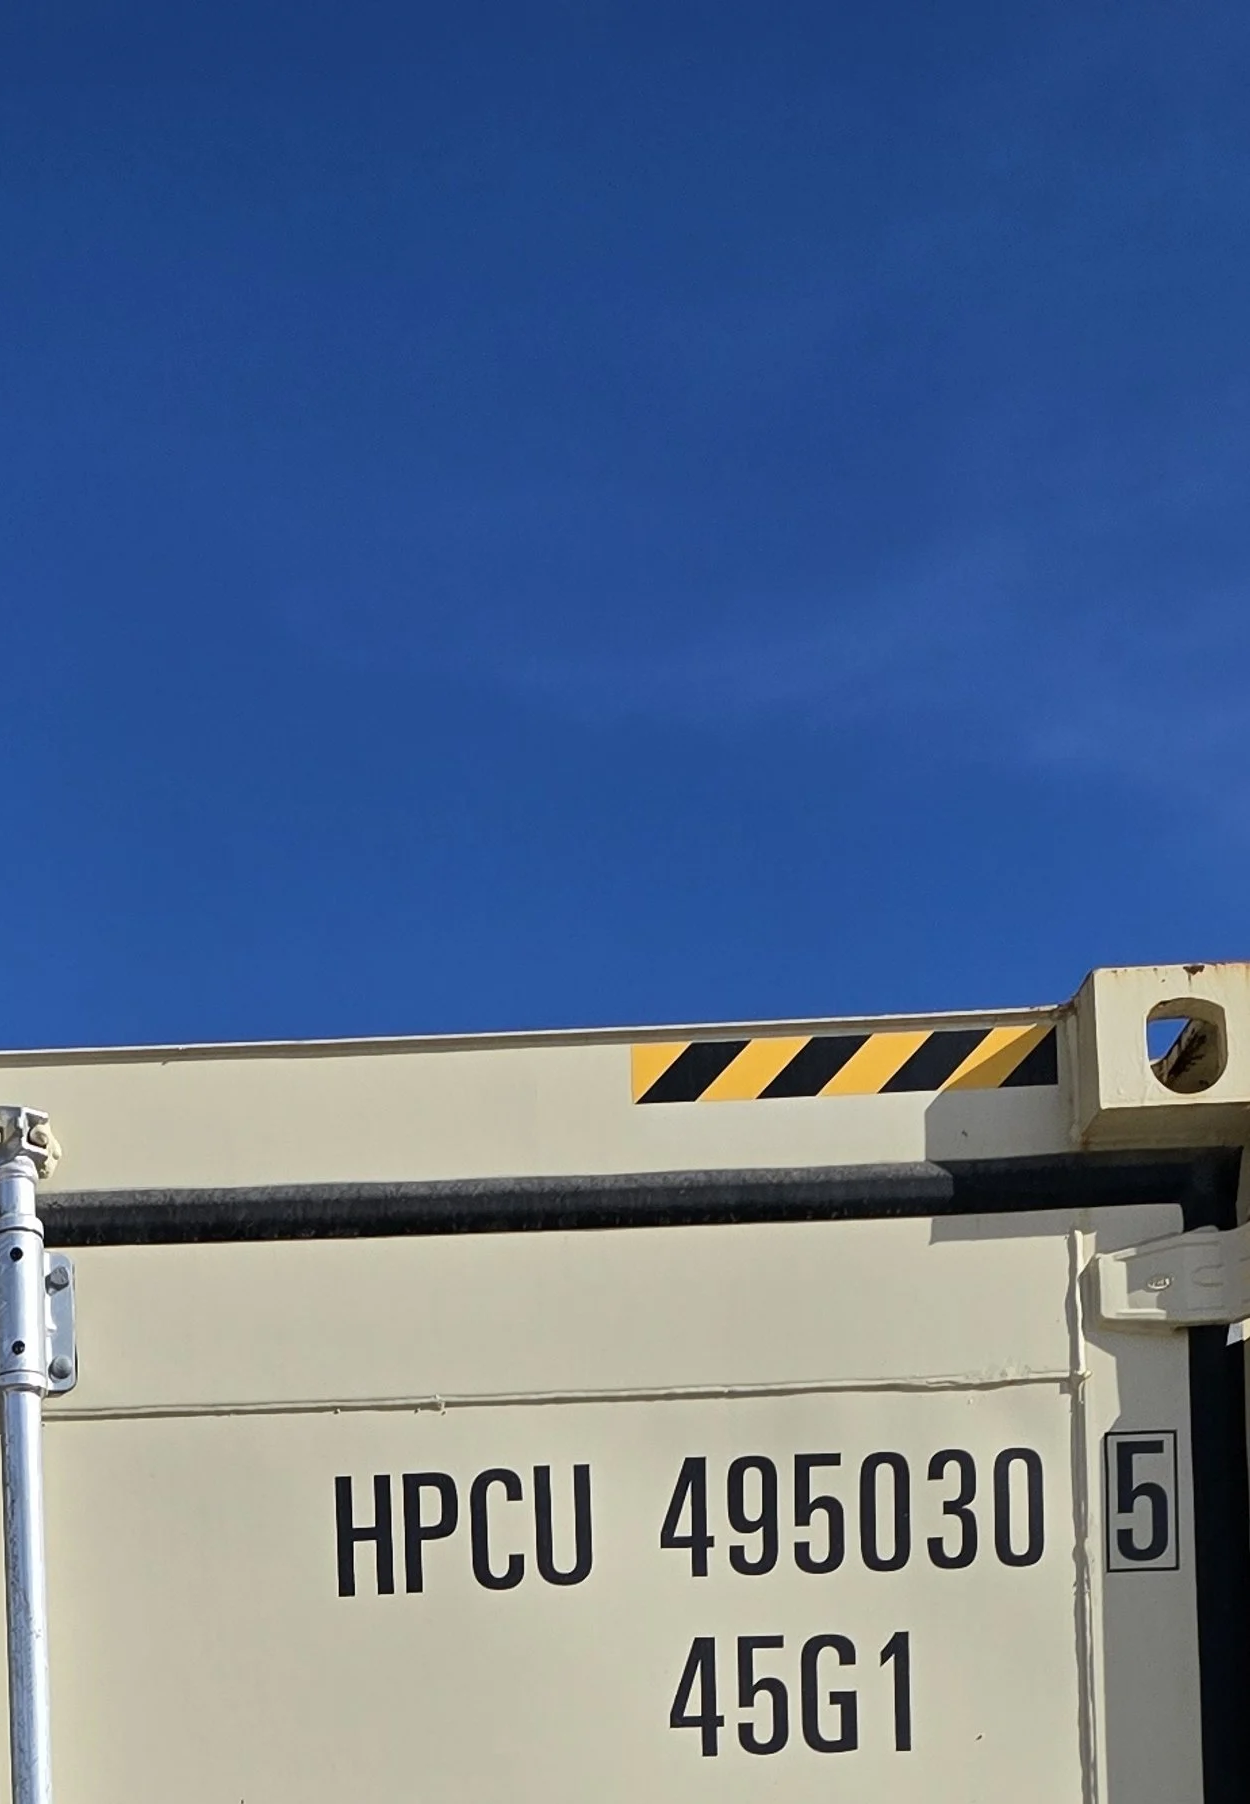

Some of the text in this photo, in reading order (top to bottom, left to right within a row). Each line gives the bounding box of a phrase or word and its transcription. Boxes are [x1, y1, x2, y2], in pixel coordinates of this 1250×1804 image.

[334, 1440, 1168, 1597] HPCU 495030 5
[670, 1631, 911, 1757] 45G1
